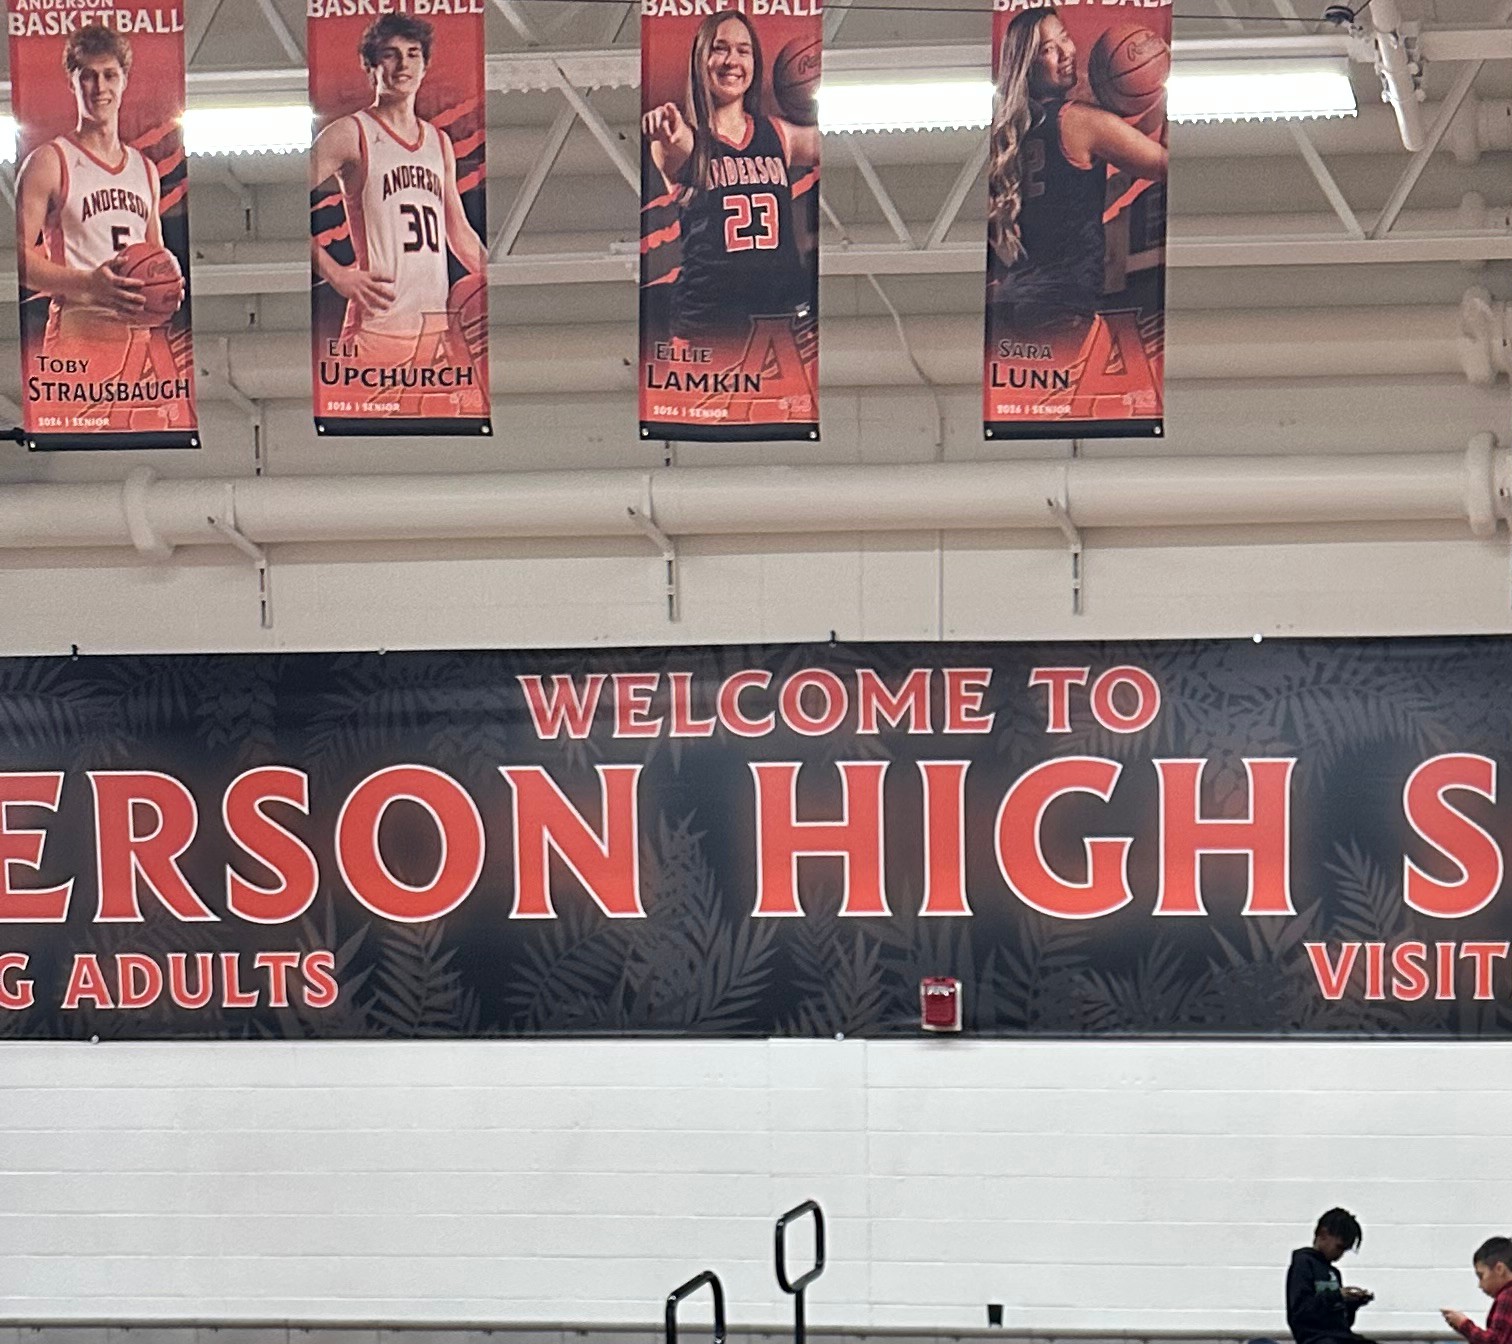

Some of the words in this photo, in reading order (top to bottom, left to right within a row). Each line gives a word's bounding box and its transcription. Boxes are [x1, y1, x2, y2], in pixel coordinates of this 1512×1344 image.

[399, 203, 439, 253] 30
[723, 193, 778, 253] 23
[329, 339, 358, 358] ELI
[655, 342, 712, 363] ELLIE
[999, 339, 1053, 360] SARA
[36, 355, 89, 374] TOBY
[320, 361, 473, 388] UPCHURCH
[647, 363, 762, 393] LAMKIN
[992, 362, 1070, 390] LUNN
[28, 376, 190, 402] STRAUSBAUGH
[517, 666, 995, 740] WELCOME
[1029, 665, 1162, 734] TO
[748, 755, 1299, 920] HIGH
[61, 951, 339, 1009] ADULTS
